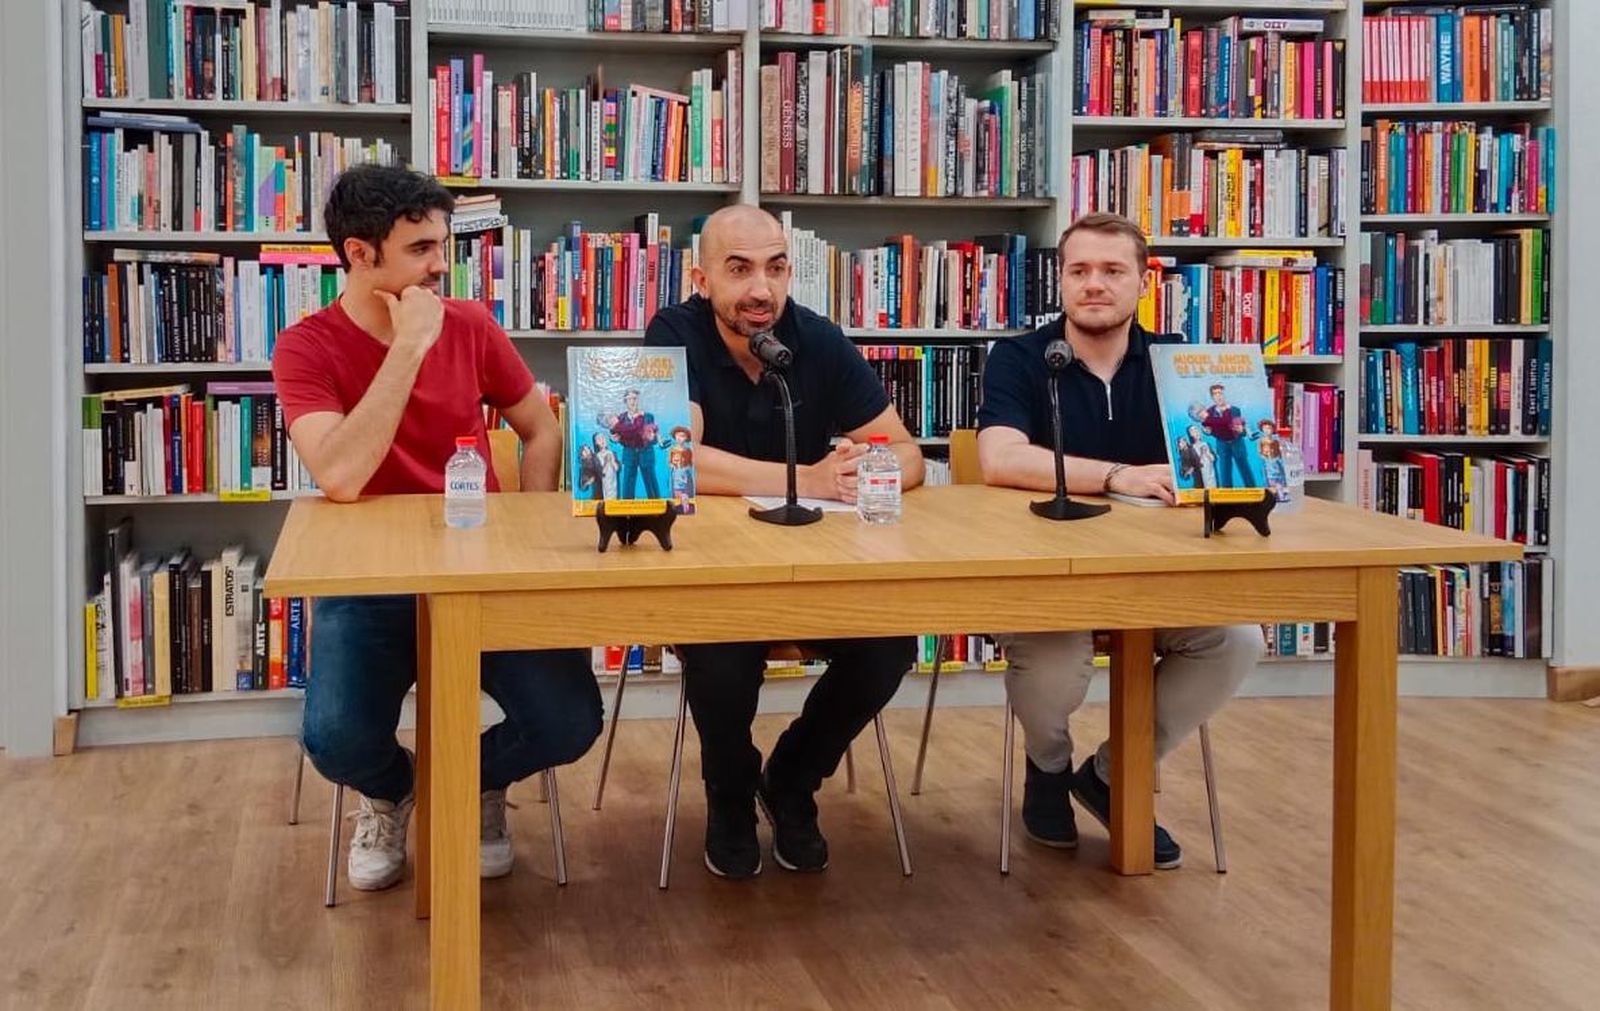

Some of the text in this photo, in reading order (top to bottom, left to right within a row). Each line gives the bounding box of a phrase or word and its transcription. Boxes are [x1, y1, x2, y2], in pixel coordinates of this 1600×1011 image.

[1440, 32, 1451, 84] WAYNE
[782, 99, 793, 149] GENESIS
[450, 481, 479, 491] CORTES
[256, 622, 266, 656] ARTE
